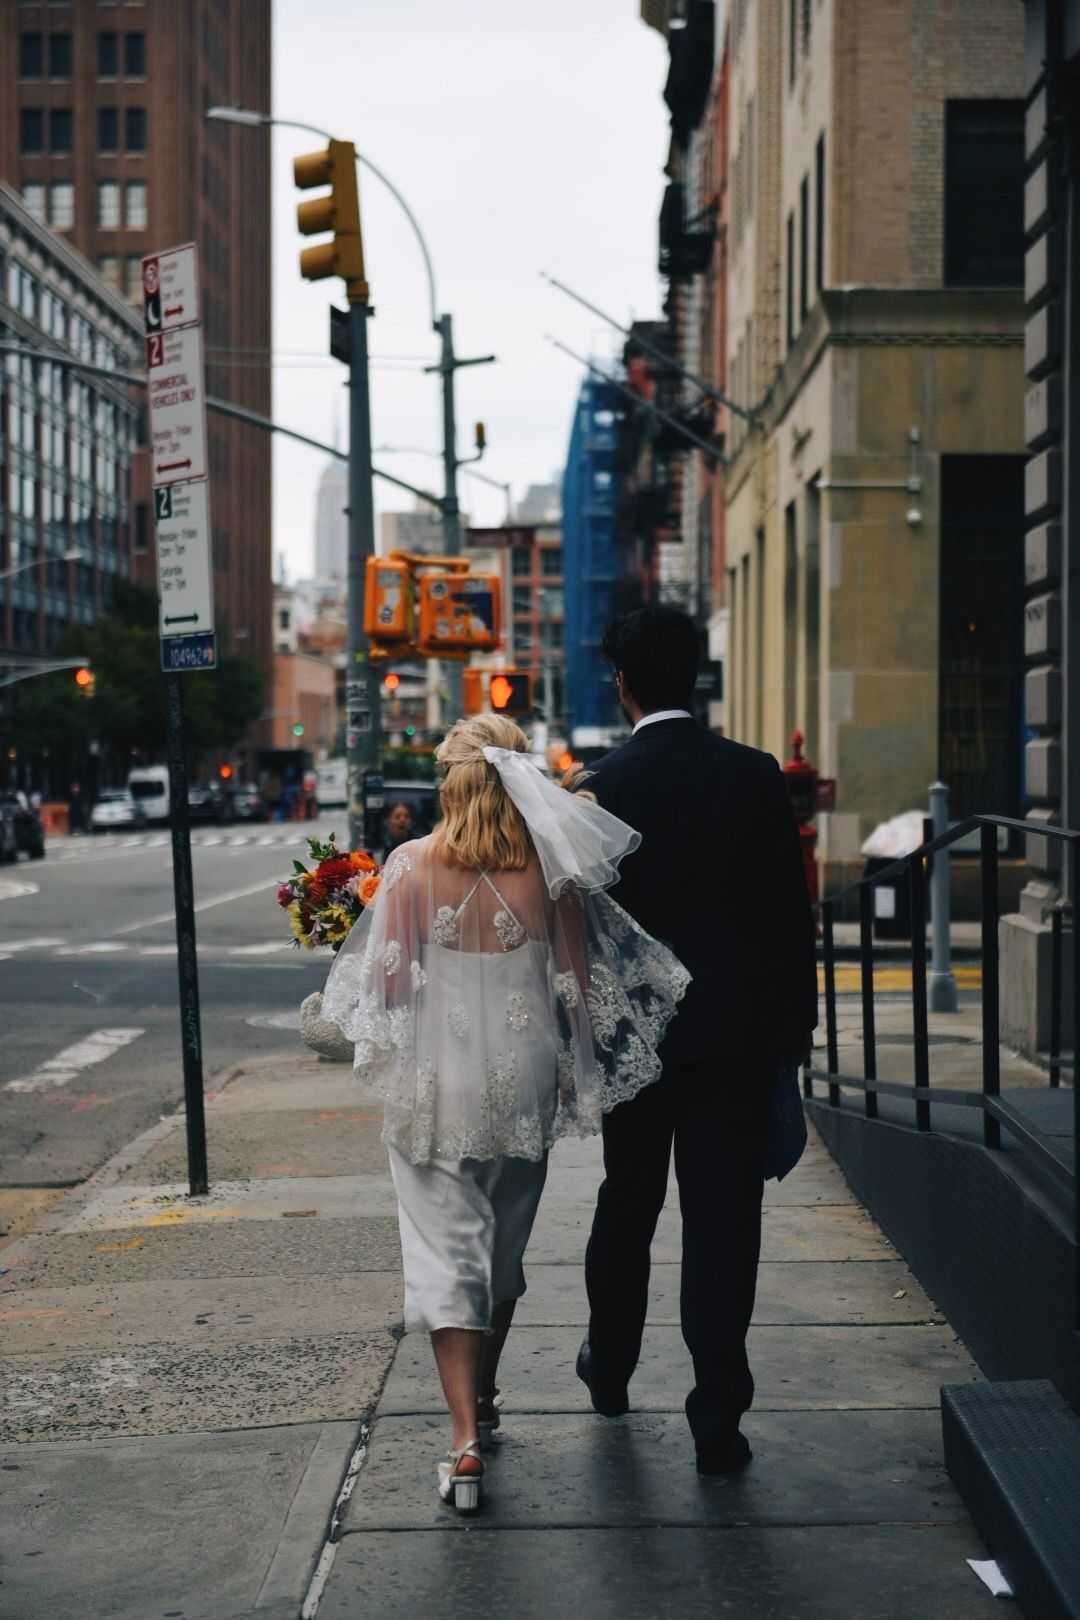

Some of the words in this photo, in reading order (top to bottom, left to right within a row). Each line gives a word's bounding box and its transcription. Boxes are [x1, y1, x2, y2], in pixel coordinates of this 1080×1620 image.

[150, 337, 161, 364] 2
[151, 373, 188, 393] COMMERCIAL
[153, 392, 179, 409] VEHICLES
[180, 387, 196, 403] ONLY
[159, 488, 169, 516] 2
[170, 646, 203, 667] 104962
